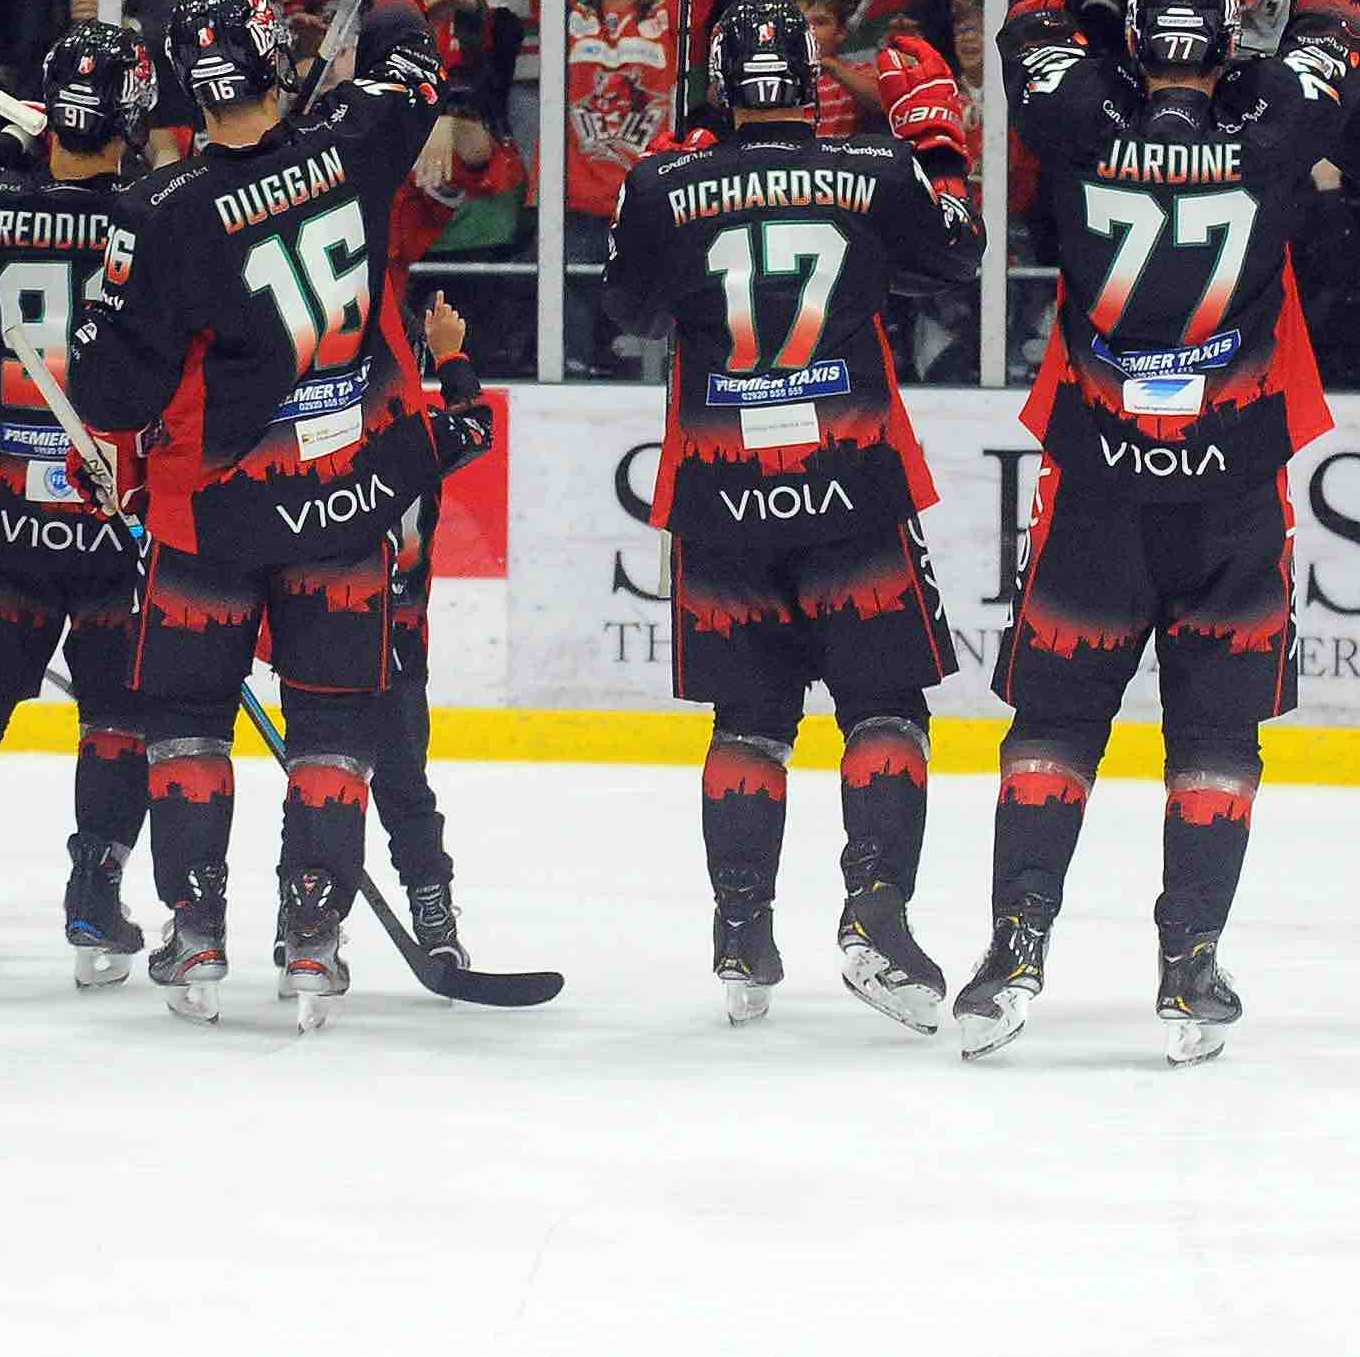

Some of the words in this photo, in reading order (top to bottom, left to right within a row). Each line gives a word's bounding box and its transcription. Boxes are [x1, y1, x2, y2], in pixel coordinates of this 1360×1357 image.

[1164, 35, 1194, 61] 77
[207, 80, 236, 101] 16
[756, 80, 780, 103] 17
[63, 107, 86, 129] 91
[1096, 138, 1243, 185] JARDINE
[213, 146, 347, 235] DUGGAN
[667, 169, 878, 227] RICHARDSON
[1083, 182, 1259, 346] 77
[241, 196, 371, 381] 16
[705, 219, 851, 373] 17
[1183, 339, 1233, 365] TAXIS
[790, 365, 841, 387] TAXIS
[1099, 434, 1227, 477] VIOLA
[275, 473, 395, 534] VIOLA
[719, 479, 855, 523] VIOLA
[0, 509, 124, 553] VIOLA
